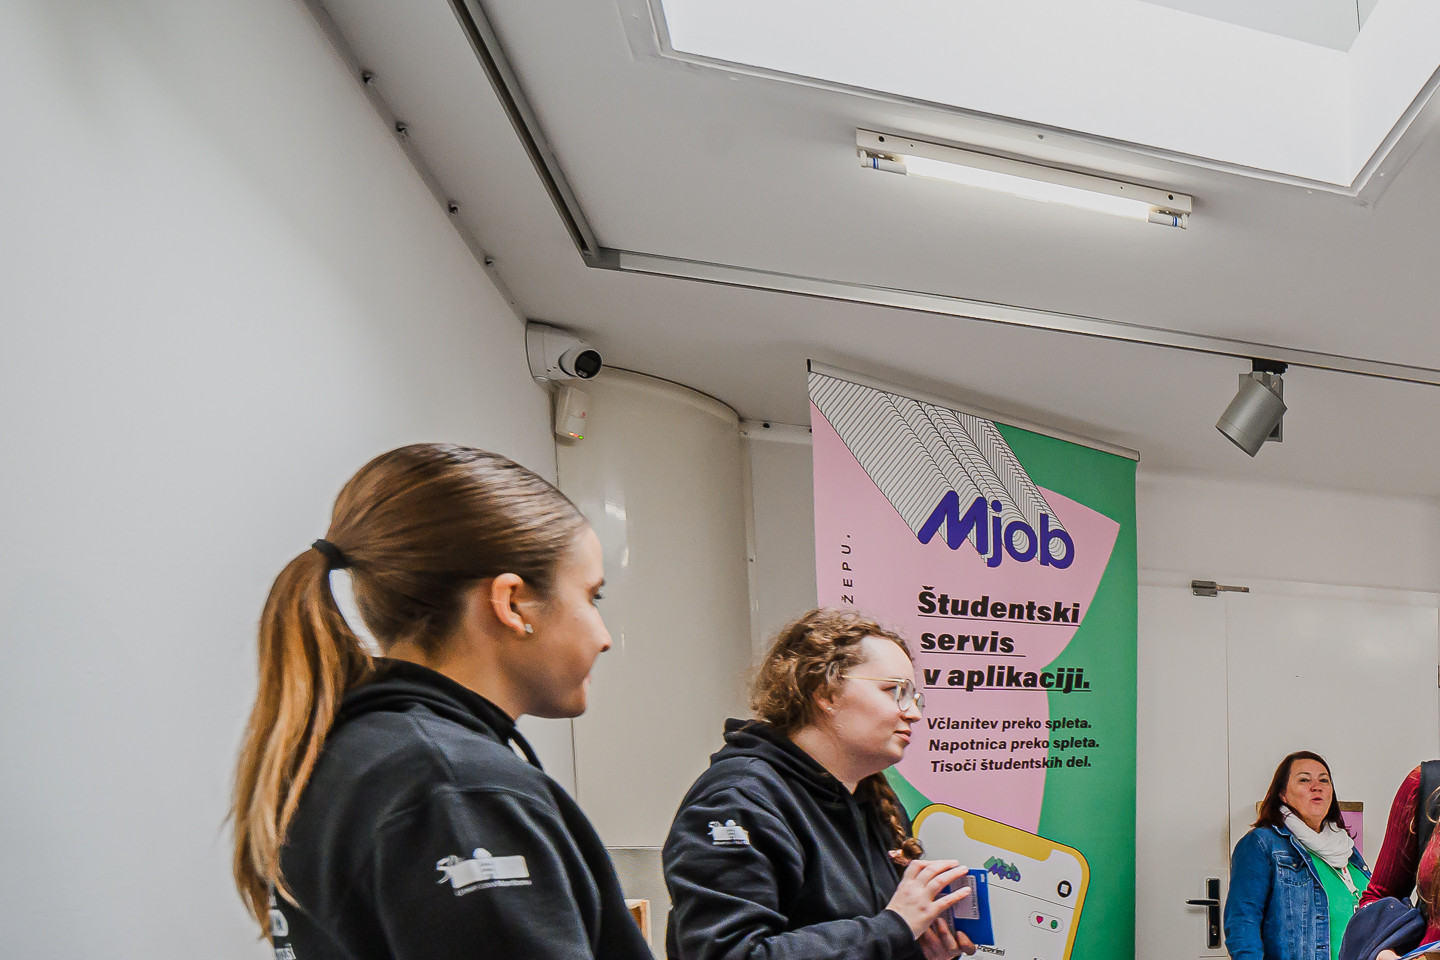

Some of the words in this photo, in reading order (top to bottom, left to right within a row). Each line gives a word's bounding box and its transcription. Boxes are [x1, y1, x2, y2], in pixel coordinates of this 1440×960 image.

[918, 490, 1075, 569] Mjob
[918, 585, 1081, 624] Študentski
[920, 631, 1015, 654] servis
[923, 668, 941, 685] v
[947, 664, 1091, 695] aplikaciji.
[927, 716, 999, 731] Včlanitev
[1001, 717, 1043, 732] preko
[1045, 717, 1092, 731] spleta.
[928, 737, 1007, 753] Napotnica
[1010, 738, 1050, 752] preko
[1053, 736, 1100, 751] spleta.
[931, 757, 977, 773] Tisoči
[980, 755, 1063, 773] študentskih
[1066, 754, 1092, 768] del.
